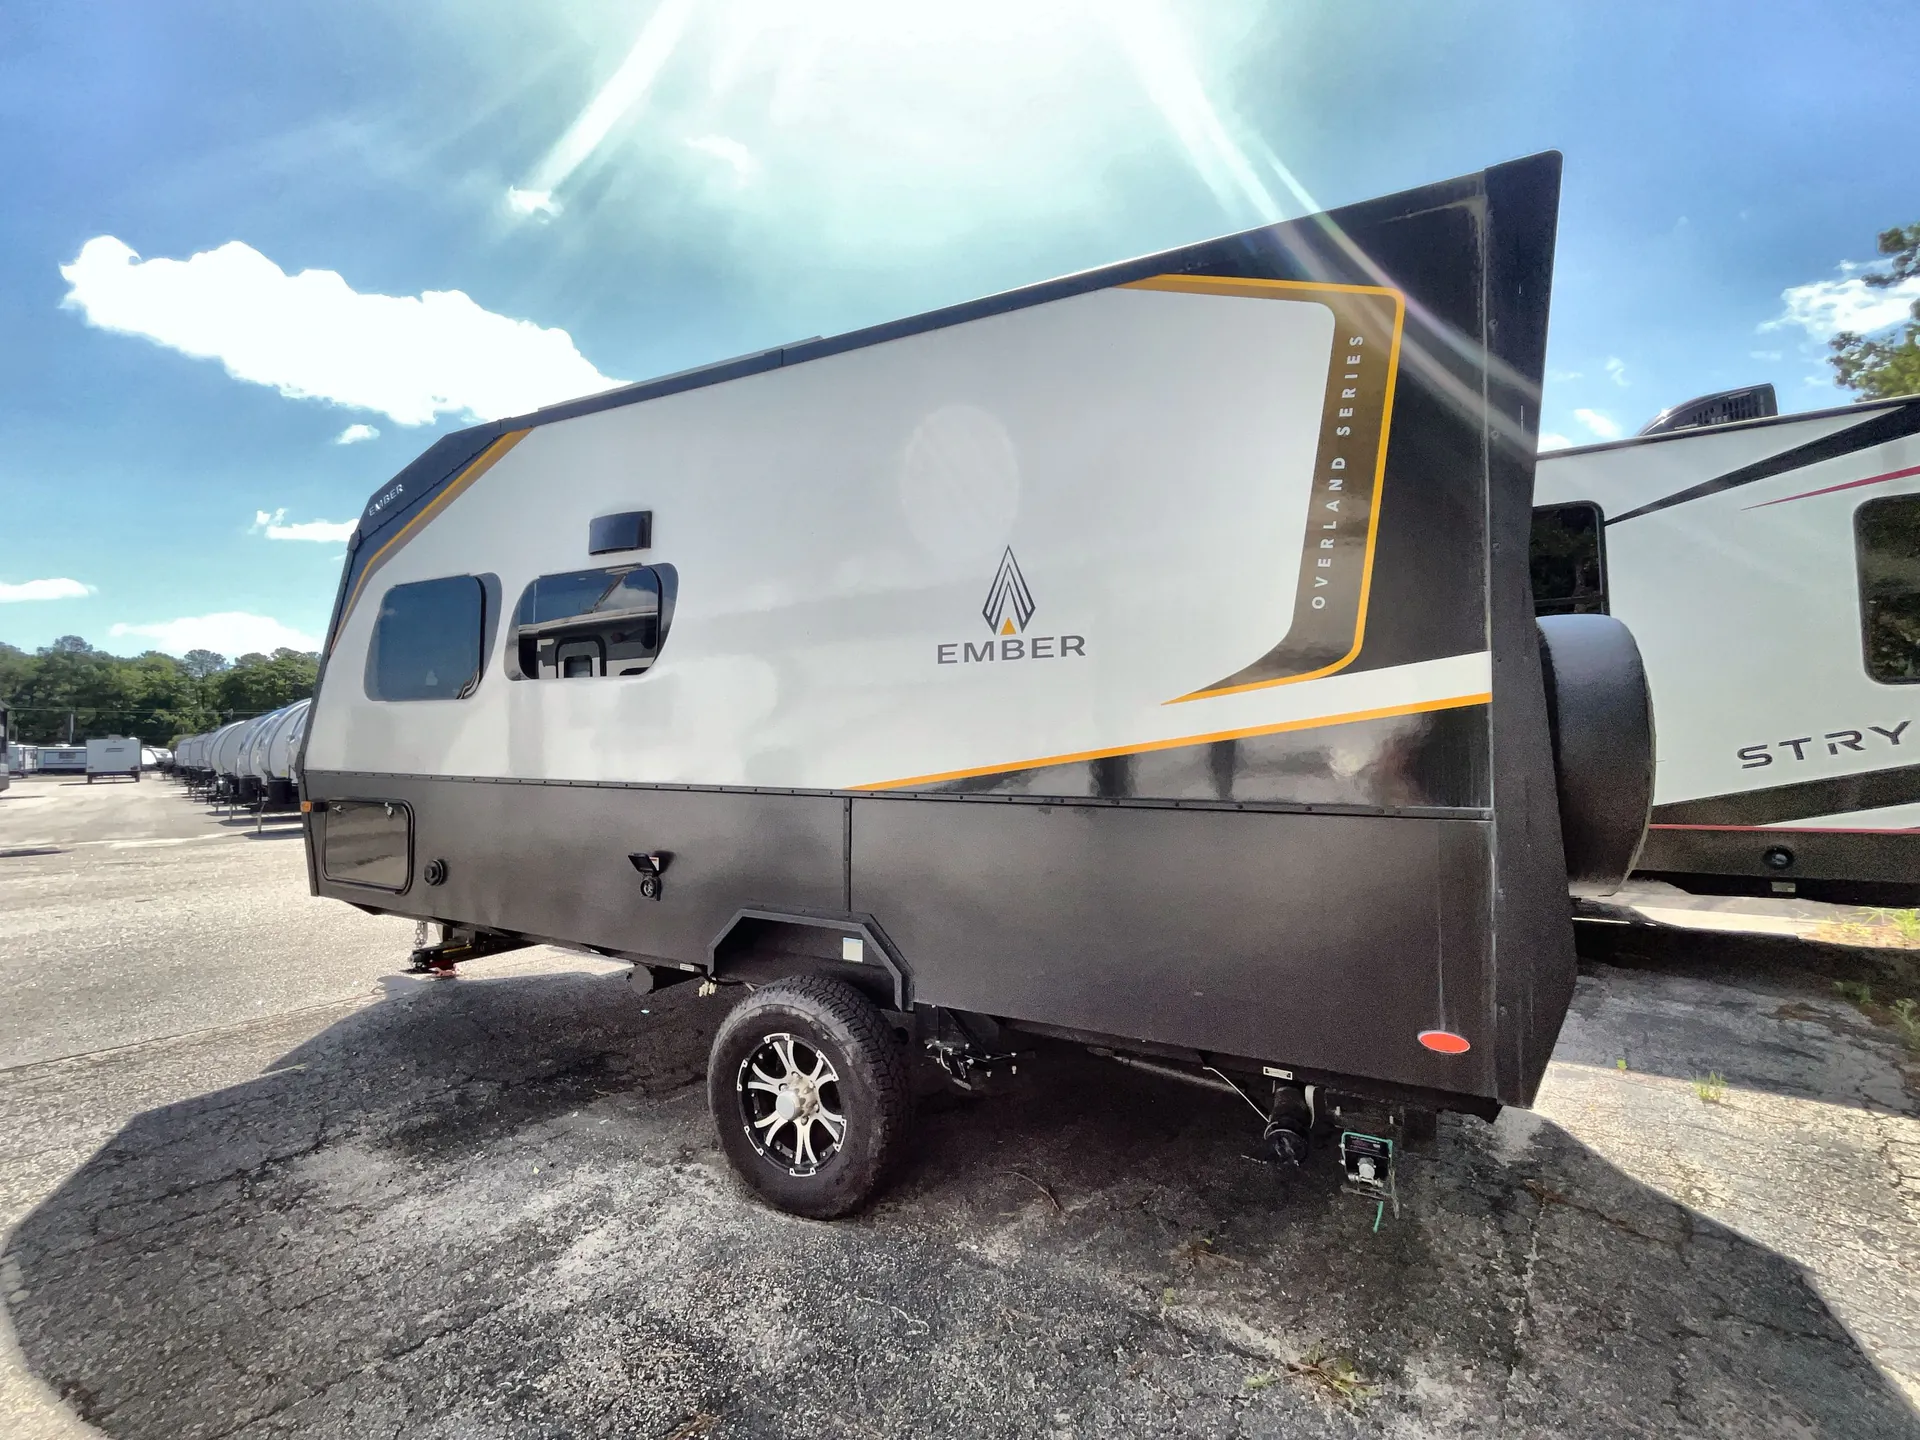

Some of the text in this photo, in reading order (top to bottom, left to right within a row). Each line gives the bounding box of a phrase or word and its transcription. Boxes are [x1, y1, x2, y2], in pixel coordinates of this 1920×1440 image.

[1311, 335, 1364, 609] OVERLAND SERIES
[369, 484, 404, 516] EMBER
[937, 635, 1086, 664] EMBER
[1735, 719, 1912, 768] STRY
